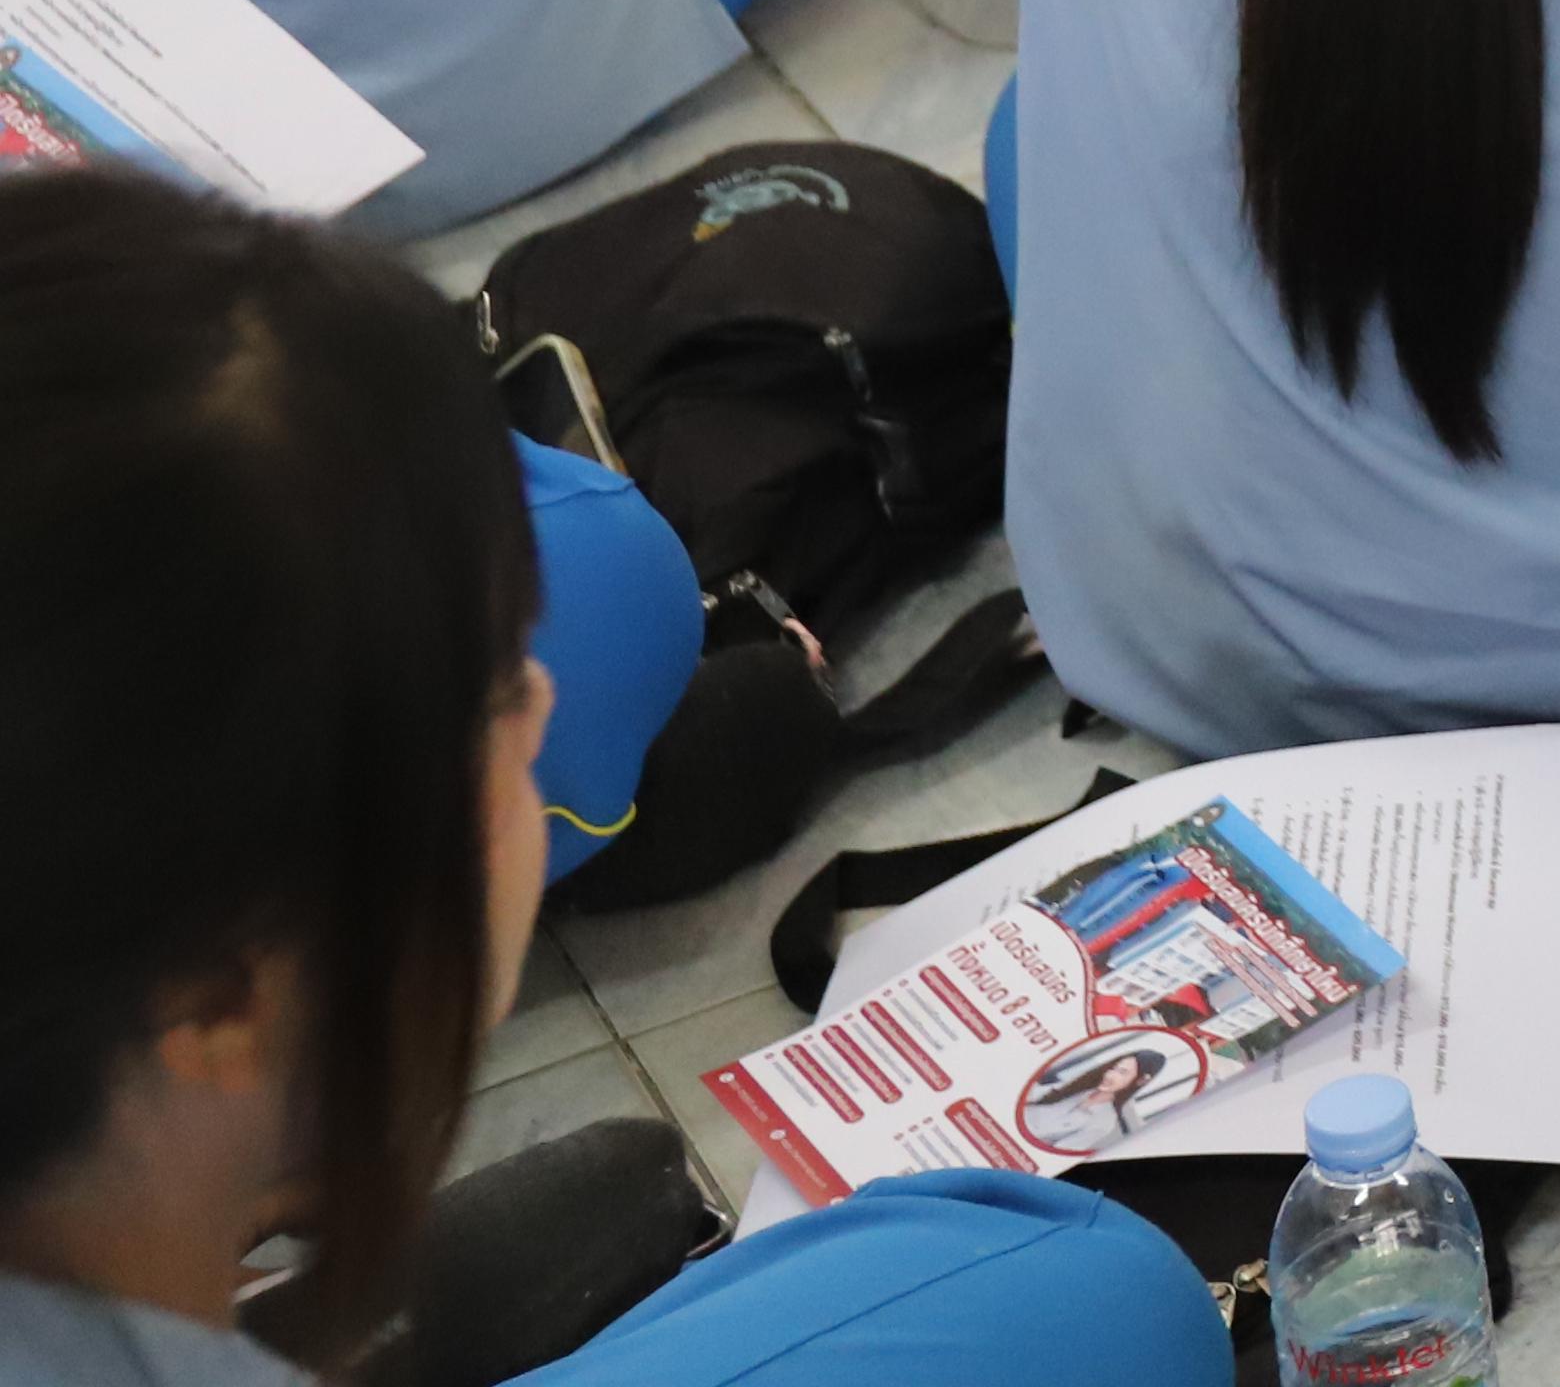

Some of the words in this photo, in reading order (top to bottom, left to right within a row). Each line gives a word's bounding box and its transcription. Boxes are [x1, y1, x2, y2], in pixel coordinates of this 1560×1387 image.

[990, 921, 1076, 1003] เปิดรับสมัคร
[1001, 995, 1030, 1015] 8
[1012, 1013, 1059, 1053] สาขา
